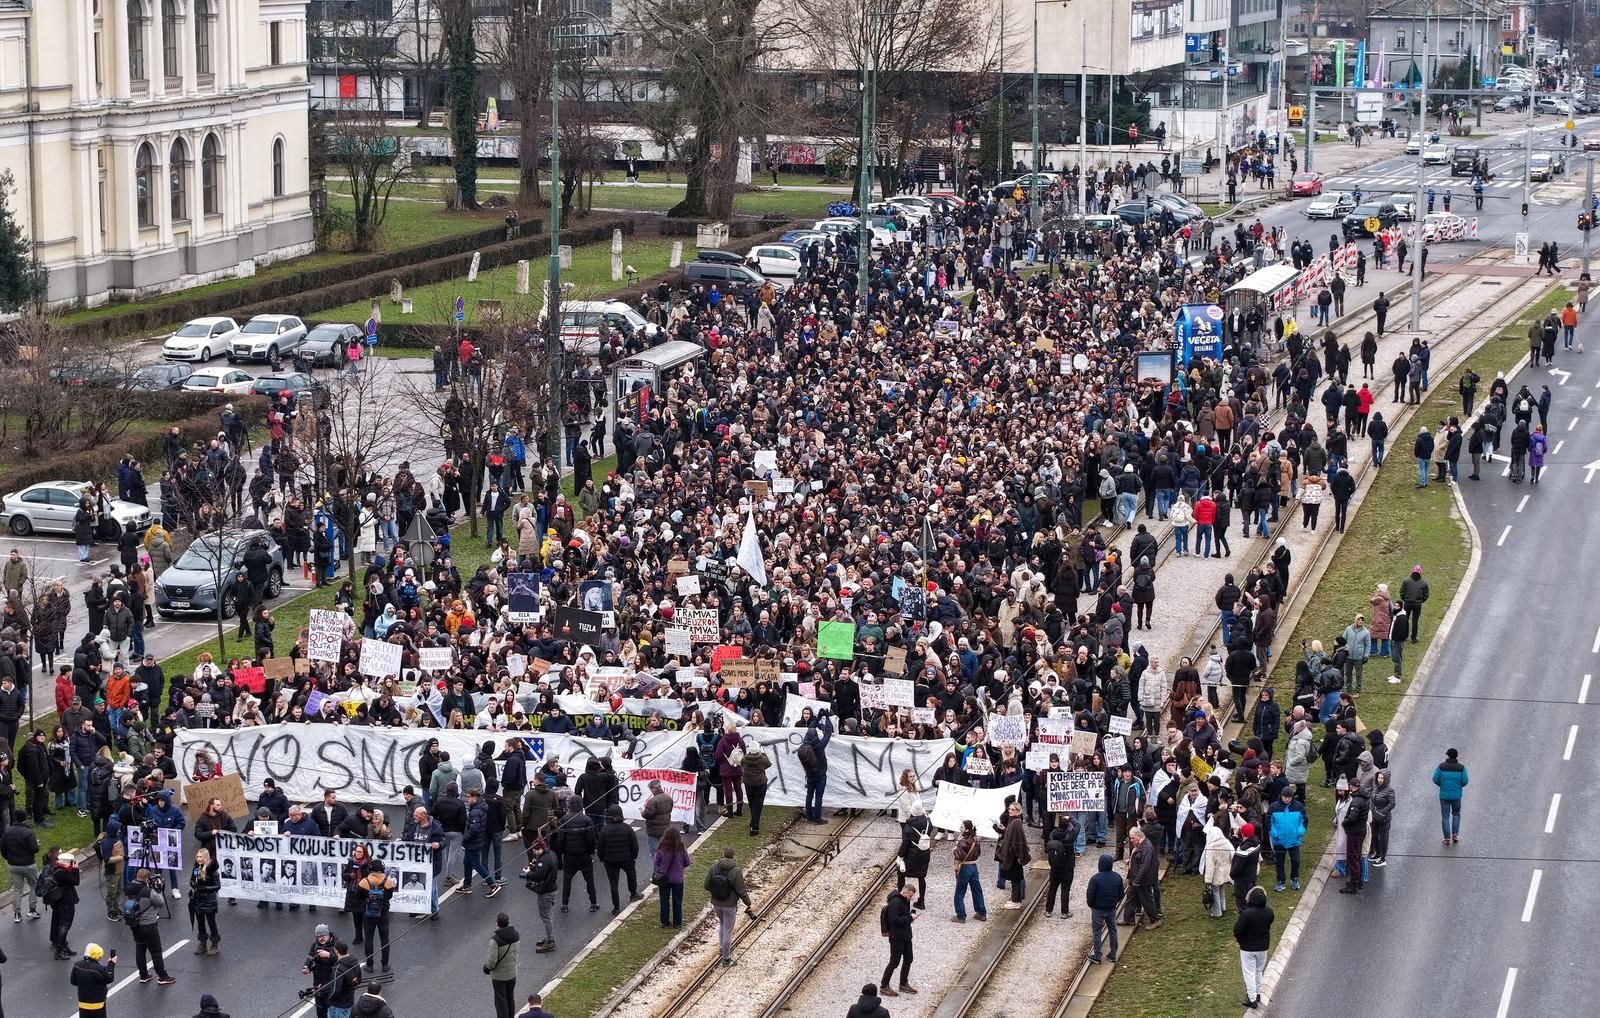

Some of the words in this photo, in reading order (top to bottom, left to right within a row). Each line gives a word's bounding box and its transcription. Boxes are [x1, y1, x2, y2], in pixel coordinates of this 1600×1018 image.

[1370, 219, 1375, 228] 5
[1188, 335, 1220, 345] VEGETA
[317, 611, 338, 619] KADA
[675, 608, 717, 619] TRAMVAJ
[579, 622, 597, 633] TUZLA
[692, 618, 717, 627] UZROK
[310, 632, 341, 645] OTPOR
[182, 733, 300, 785] OVO
[1050, 782, 1060, 792] DA
[1061, 781, 1069, 791] SE
[1050, 789, 1090, 801] MINISTRICA
[1050, 799, 1081, 810] OSTAVKU
[217, 831, 284, 855] MLADOST
[377, 842, 434, 864] SISTEM
